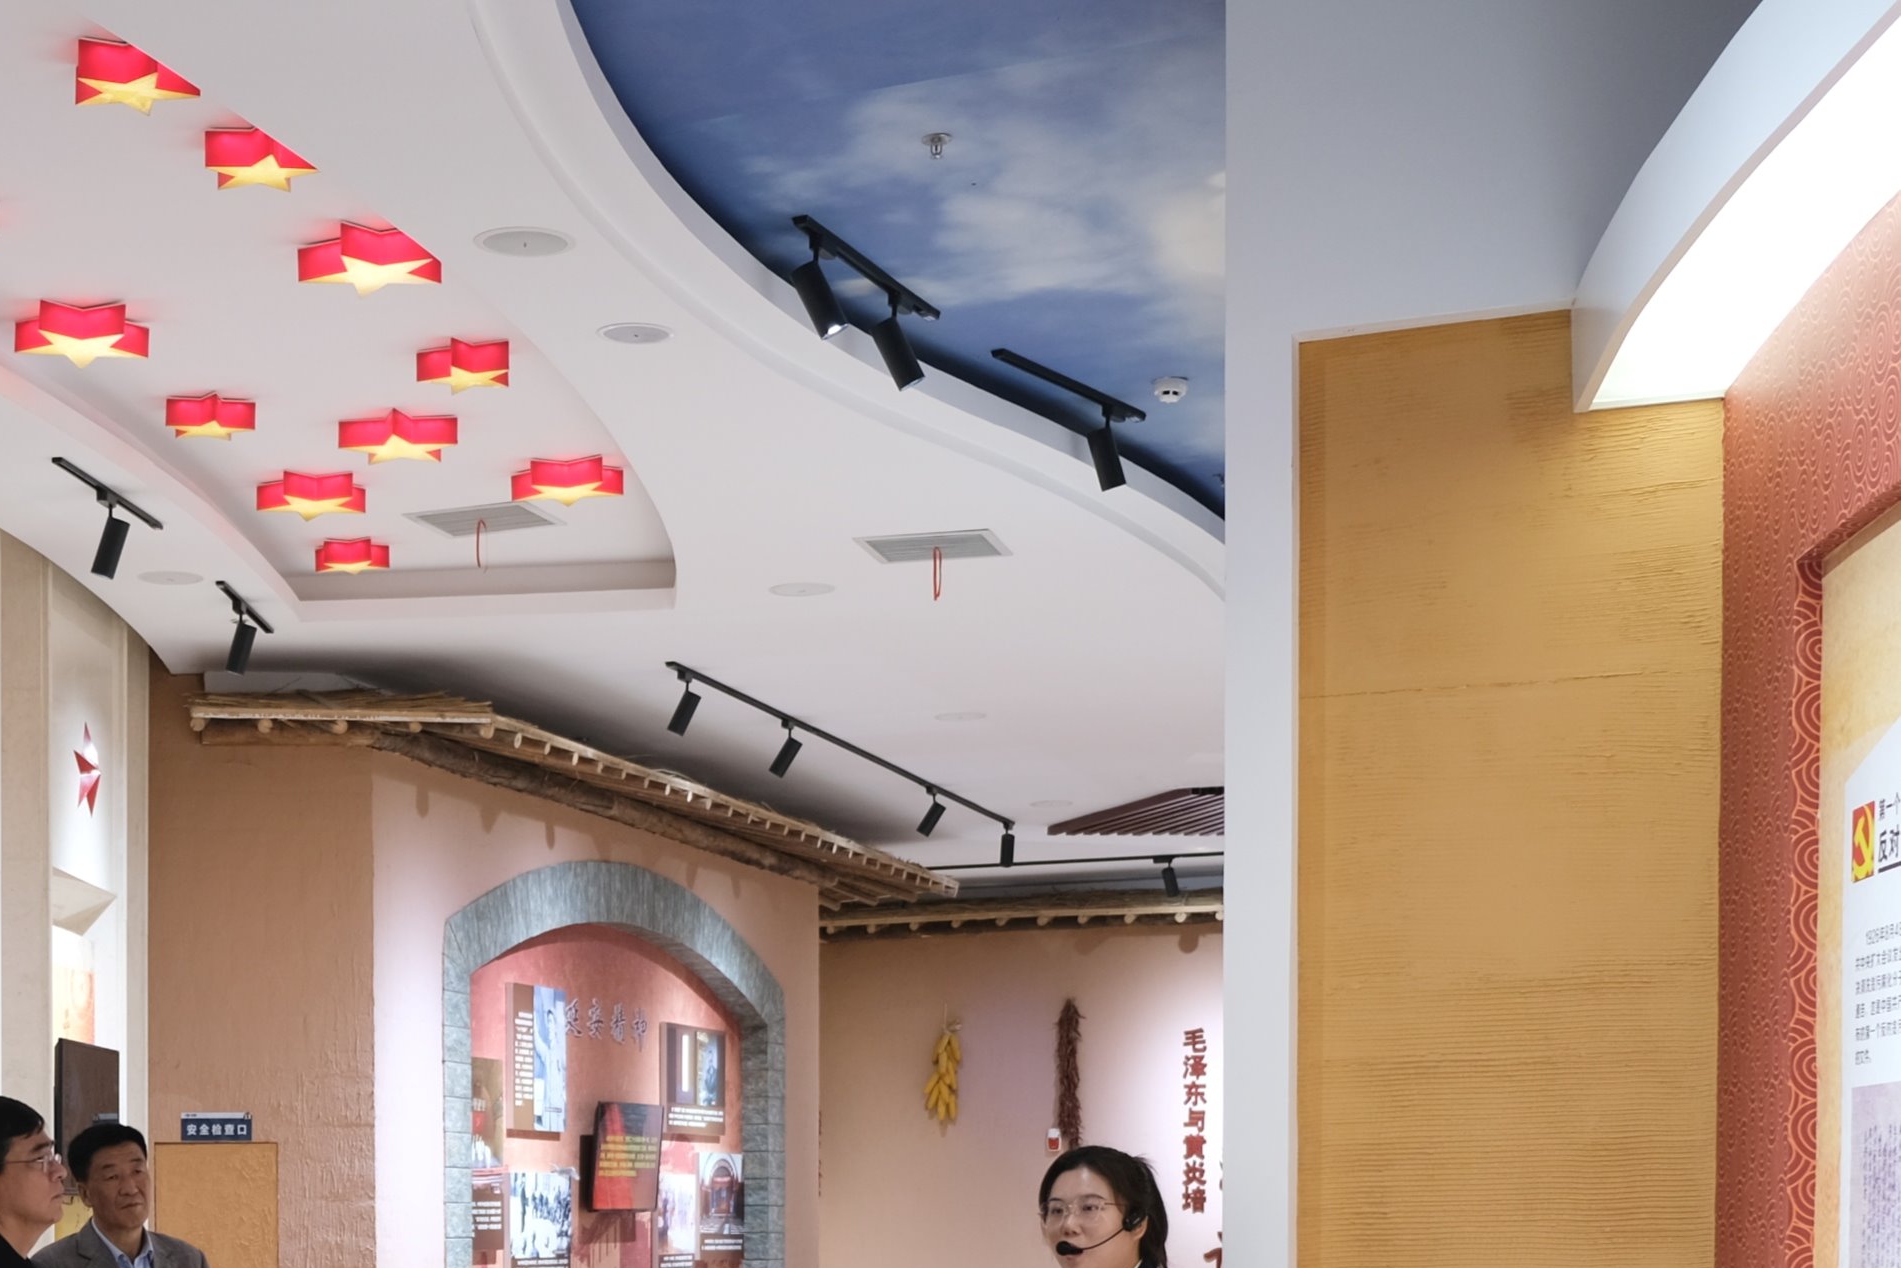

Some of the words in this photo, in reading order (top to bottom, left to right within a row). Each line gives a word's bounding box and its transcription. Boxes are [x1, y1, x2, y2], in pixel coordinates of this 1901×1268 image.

[1878, 824, 1901, 862] 反对
[186, 1123, 248, 1136] 安全检查口
[1182, 1028, 1208, 1214] 毛泽东与黄炎培
